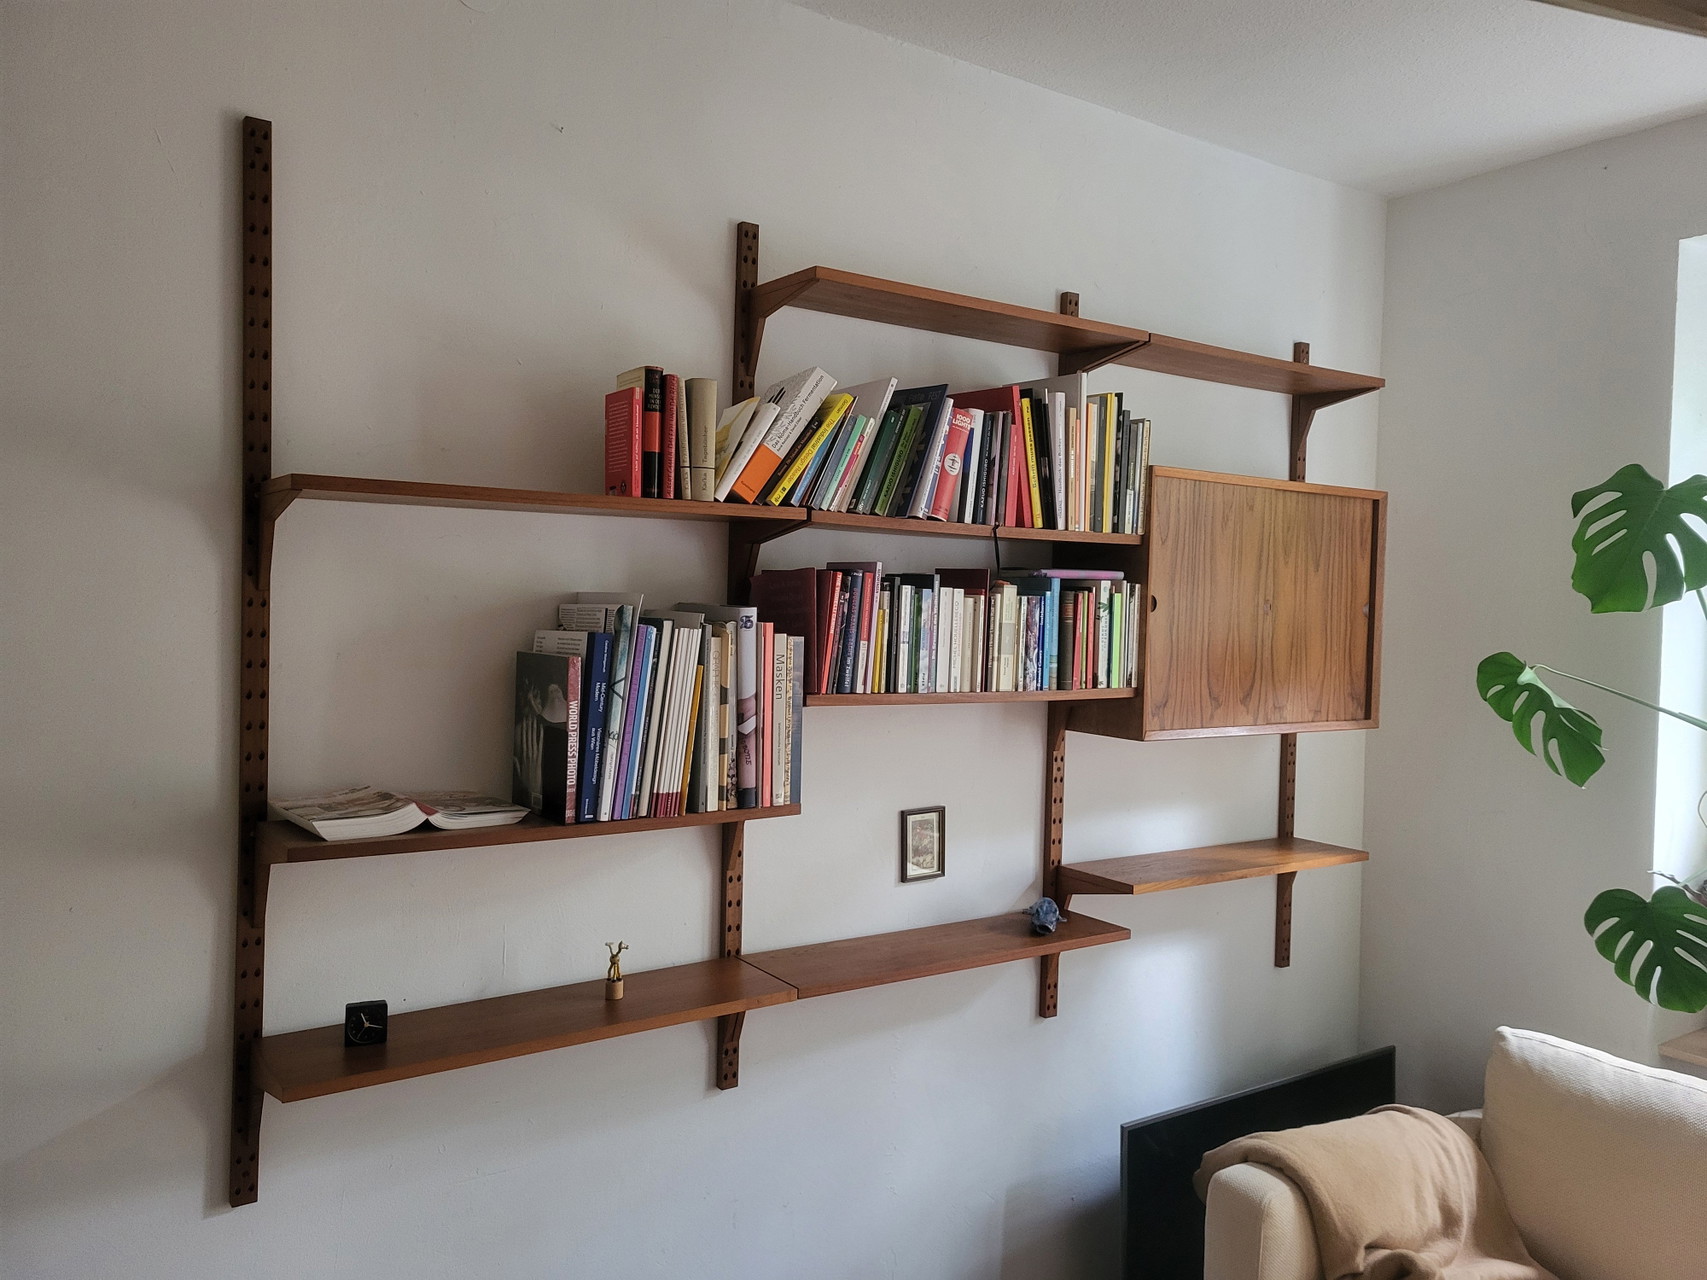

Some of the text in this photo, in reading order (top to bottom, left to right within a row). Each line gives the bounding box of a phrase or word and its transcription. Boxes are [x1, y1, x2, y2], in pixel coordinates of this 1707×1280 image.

[771, 373, 825, 449] Das Noma-Handbuch Fermentation
[825, 418, 835, 429] The
[952, 418, 971, 430] LIGHTS
[956, 414, 970, 423] 1000
[810, 427, 829, 450] Industrial
[797, 448, 813, 467] Design
[786, 465, 802, 485] Reader
[883, 449, 904, 498] KAZUO ISHIGURO
[851, 587, 859, 613] DOUGLAS
[847, 657, 852, 665] im
[776, 654, 785, 700] Masken
[598, 682, 606, 712] Mid-Century
[567, 700, 579, 731] WORLD
[566, 731, 578, 758] PRESS
[566, 758, 577, 786] PHOTO
[591, 753, 600, 785] Möbeldesign
